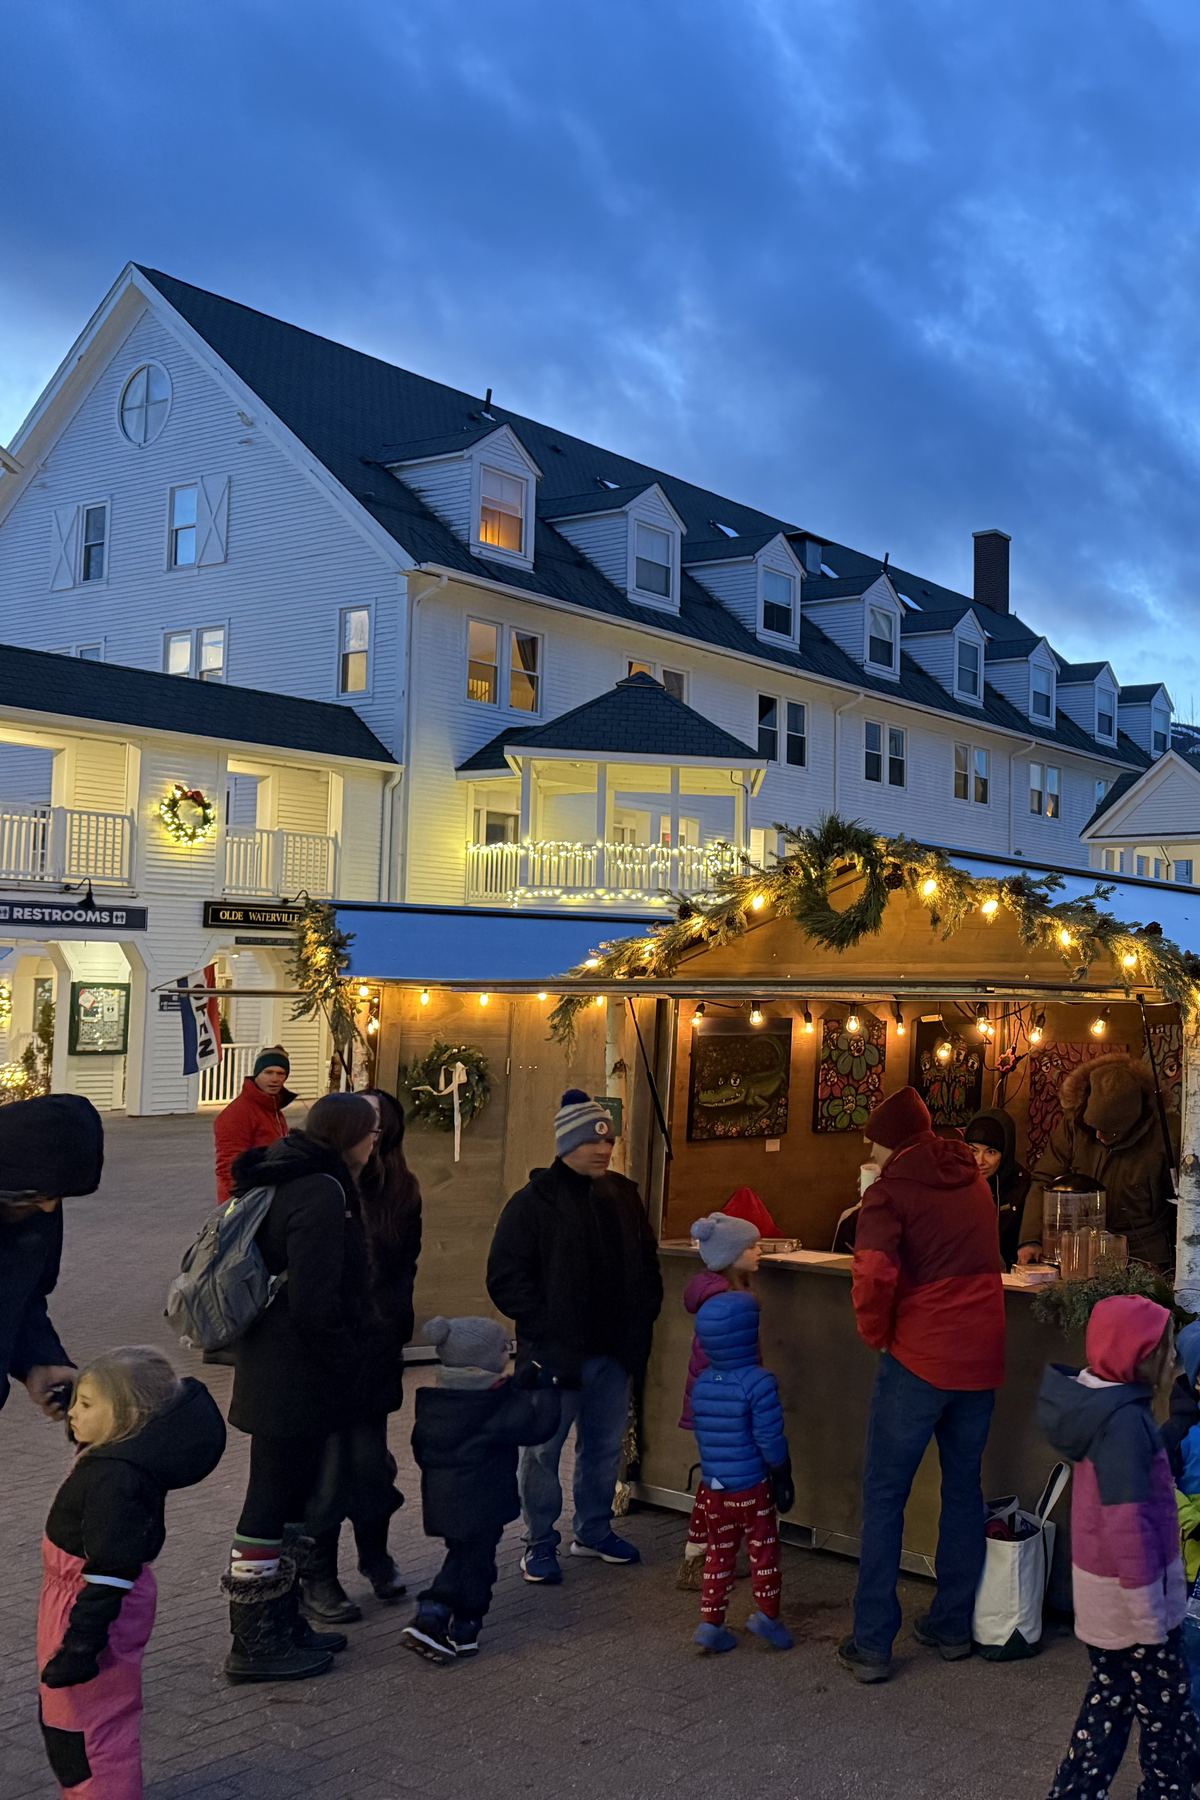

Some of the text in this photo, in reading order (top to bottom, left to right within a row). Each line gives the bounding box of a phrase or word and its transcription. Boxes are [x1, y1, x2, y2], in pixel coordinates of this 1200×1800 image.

[12, 907, 111, 923] RESTROOMS
[219, 910, 300, 923] OLDE WATERVILLE
